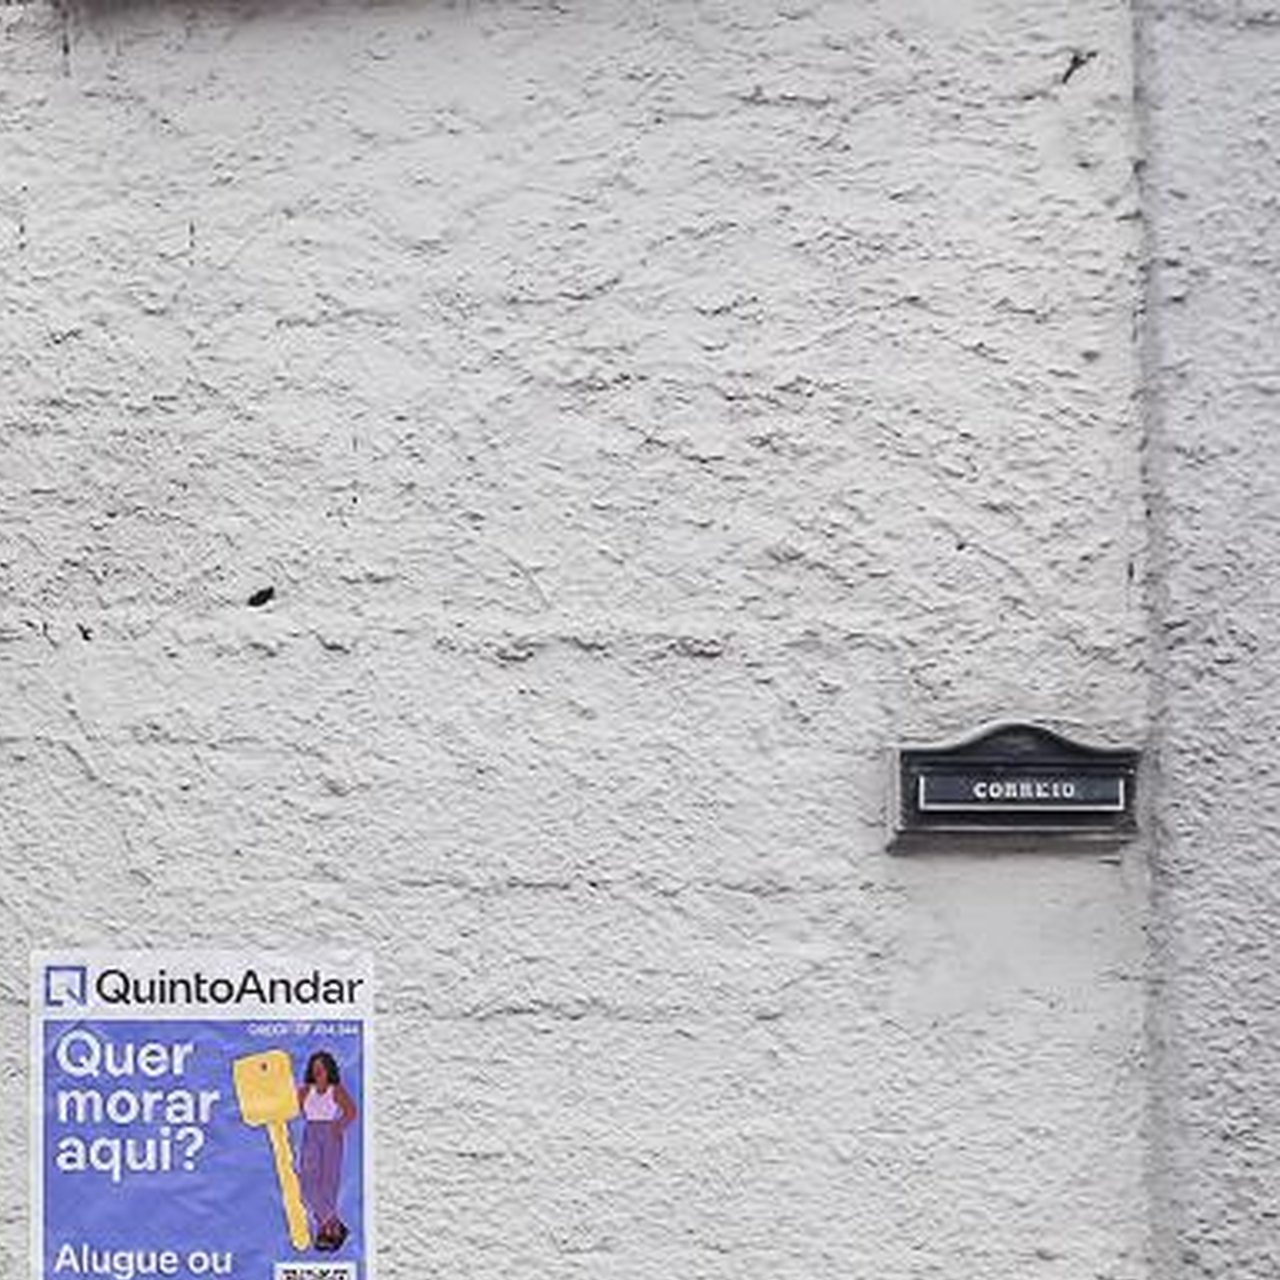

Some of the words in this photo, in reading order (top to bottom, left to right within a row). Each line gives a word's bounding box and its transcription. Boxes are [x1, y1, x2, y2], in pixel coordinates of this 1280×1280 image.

[973, 782, 1075, 799] CORREIO
[95, 968, 364, 1005] QuintoAndar
[56, 1029, 194, 1078] Quer
[57, 1089, 221, 1124] morar
[56, 1127, 204, 1182] aqui?
[54, 1244, 178, 1280] Alugue
[188, 1251, 232, 1274] ou
